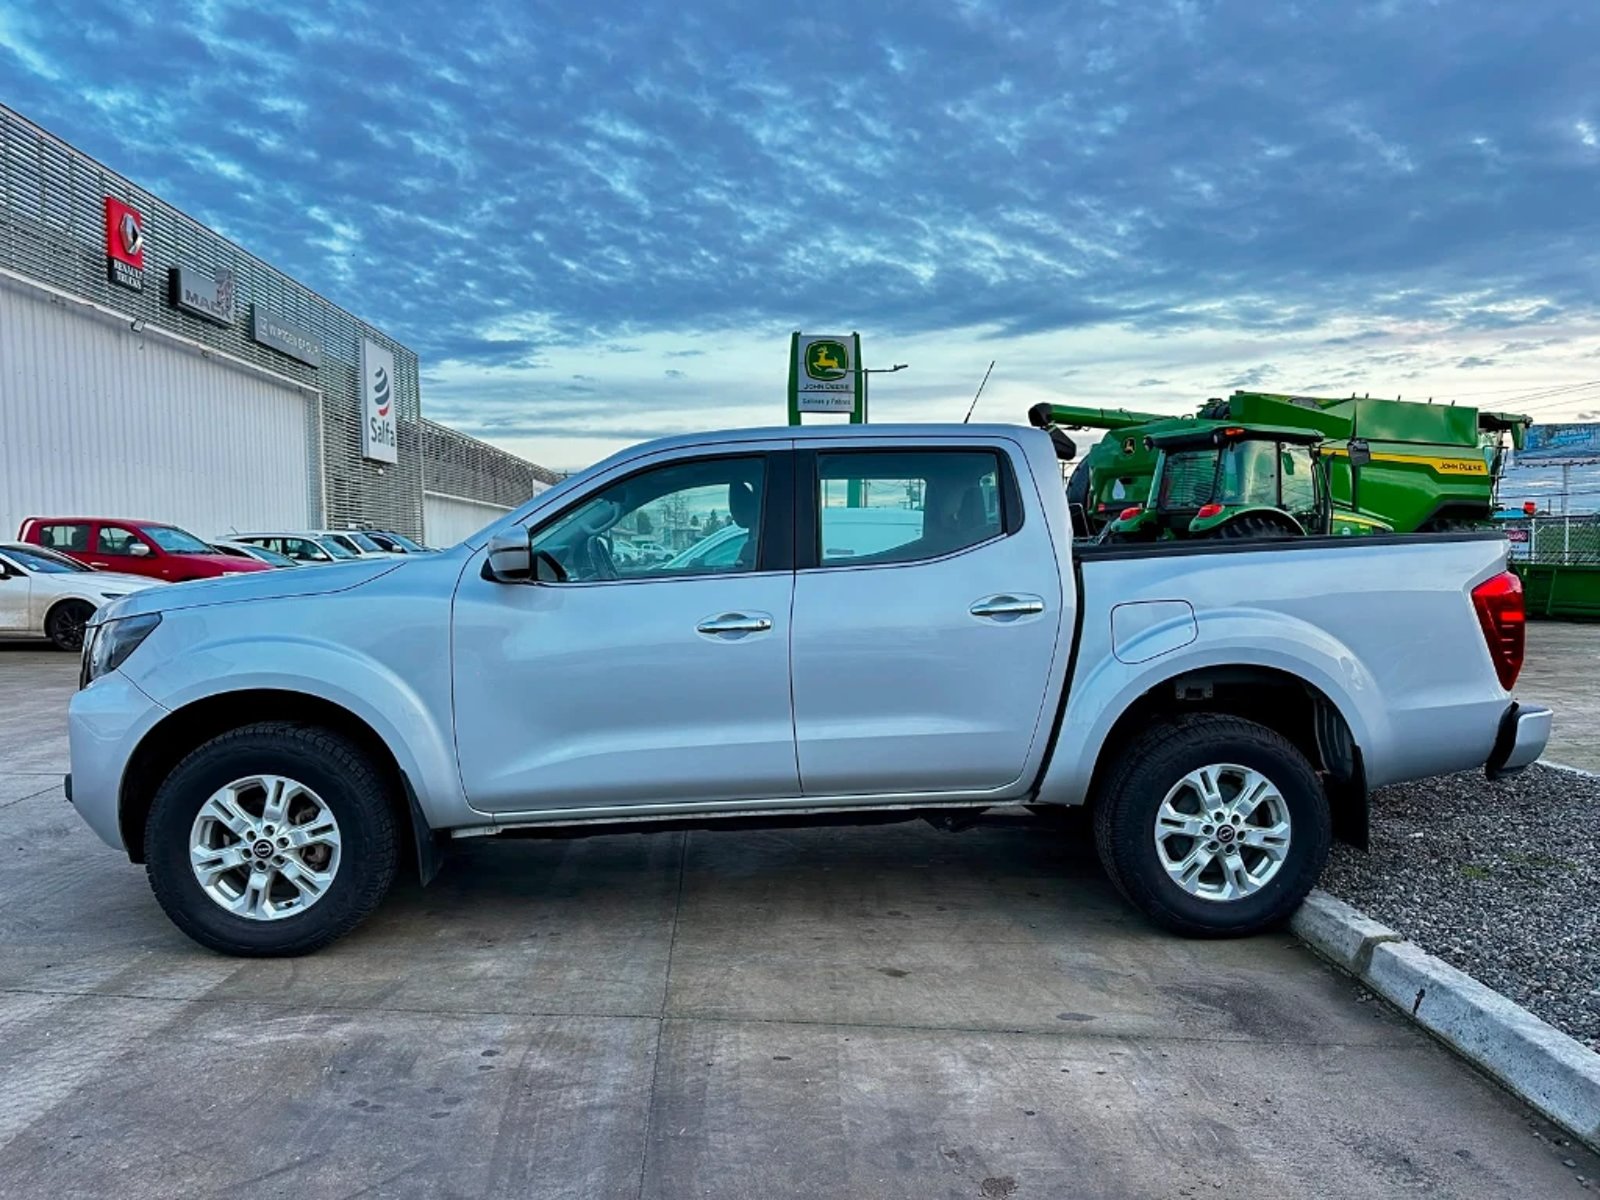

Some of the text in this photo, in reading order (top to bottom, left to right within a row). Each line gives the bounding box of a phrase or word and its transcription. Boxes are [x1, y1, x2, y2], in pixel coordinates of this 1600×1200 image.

[113, 258, 142, 280] RENAULT
[116, 270, 142, 290] TRUCKS
[370, 416, 396, 447] Salfa
[1440, 461, 1482, 471] JOHN DEERE
